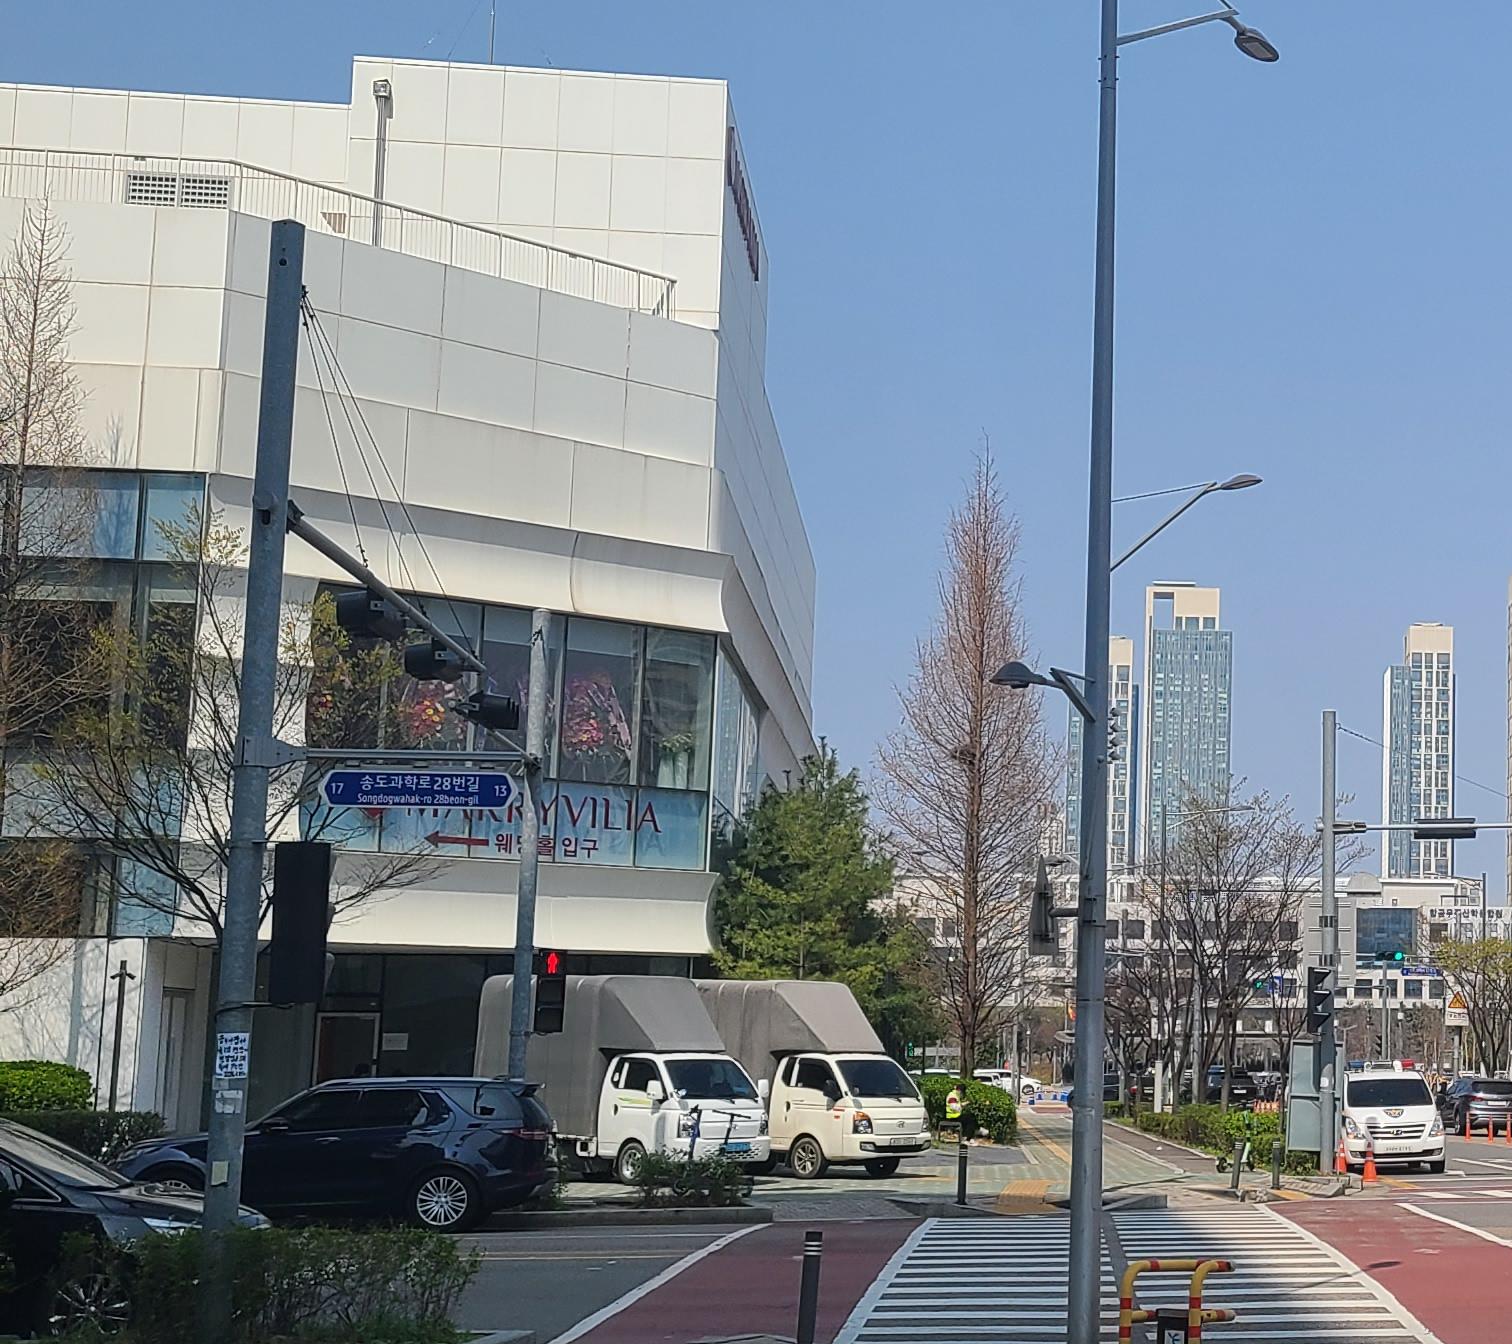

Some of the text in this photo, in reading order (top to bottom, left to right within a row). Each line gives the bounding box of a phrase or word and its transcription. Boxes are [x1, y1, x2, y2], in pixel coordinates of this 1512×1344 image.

[330, 774, 507, 797] 17 송도과학로28번길 13
[357, 792, 479, 806] Songdogwahak-ro 28beon-gil
[407, 792, 662, 834] RYVILIA
[495, 833, 554, 857] 웨홀
